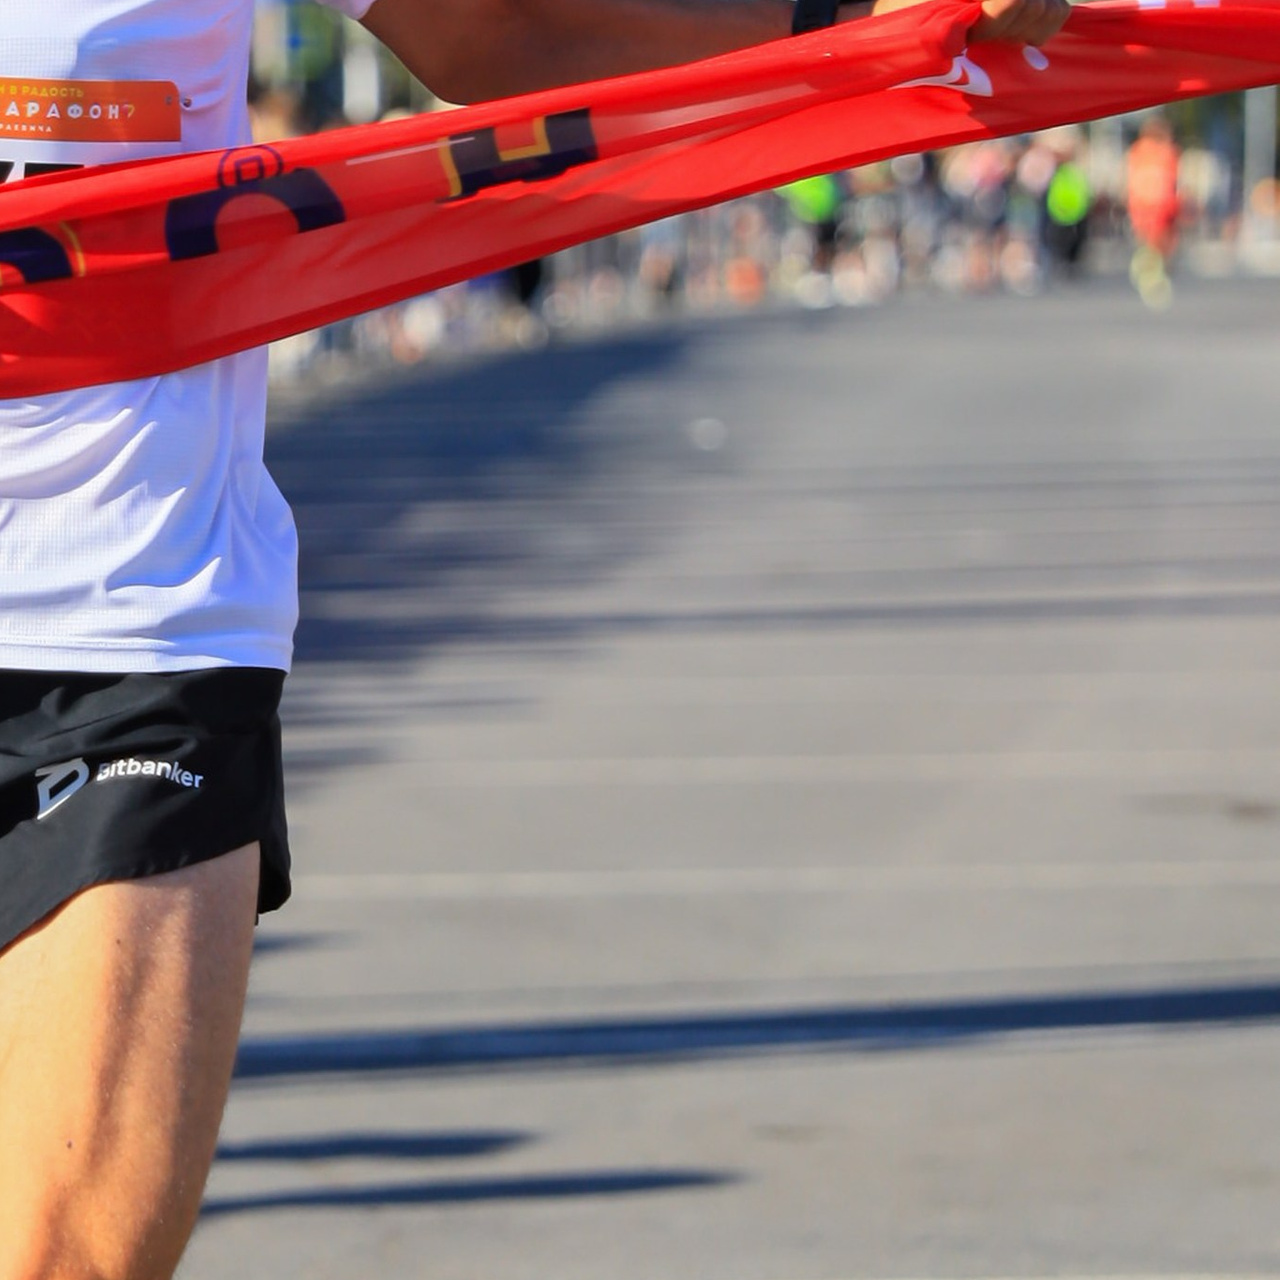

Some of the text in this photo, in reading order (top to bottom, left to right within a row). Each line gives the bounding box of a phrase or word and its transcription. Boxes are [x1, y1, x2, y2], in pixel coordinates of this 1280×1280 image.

[9, 84, 21, 95] В
[22, 84, 85, 98] РАДОСТЬ
[96, 757, 204, 789] Bitbanker
